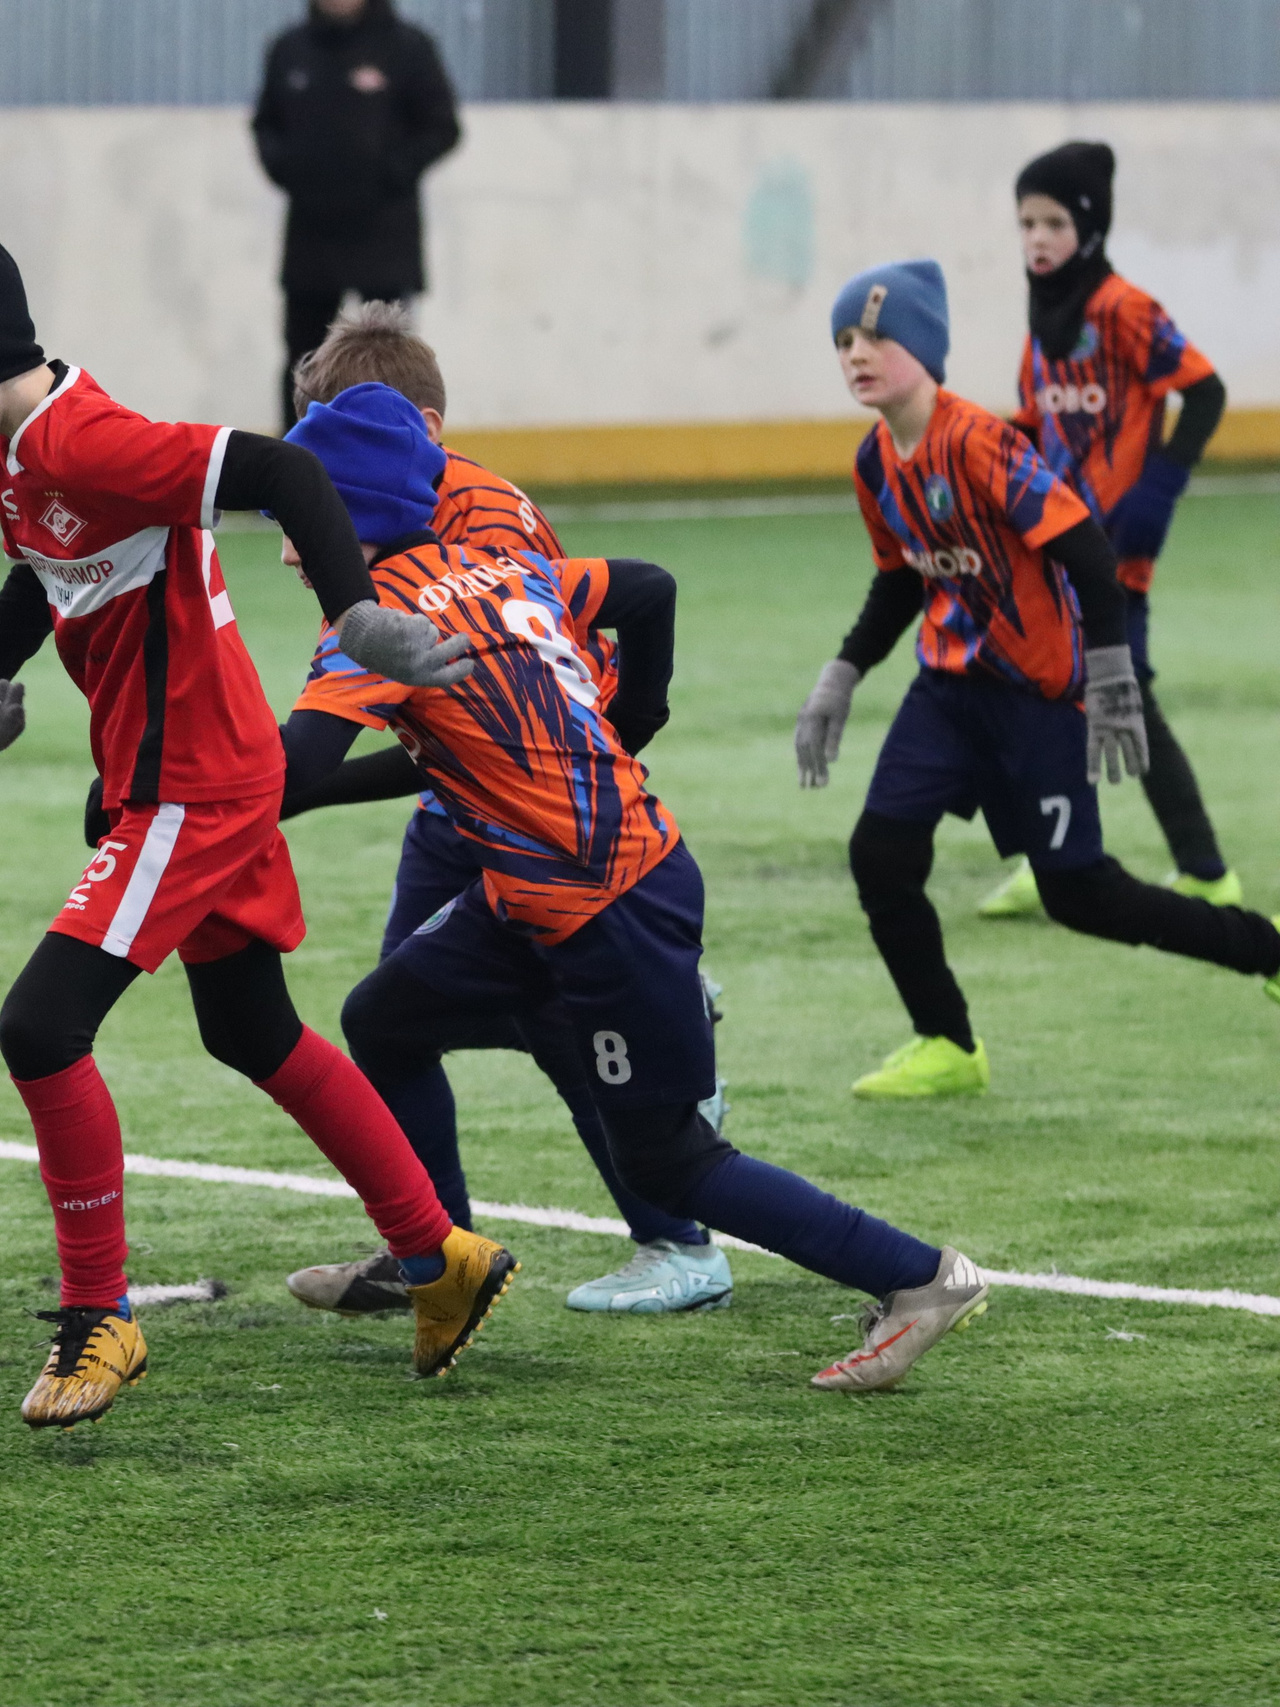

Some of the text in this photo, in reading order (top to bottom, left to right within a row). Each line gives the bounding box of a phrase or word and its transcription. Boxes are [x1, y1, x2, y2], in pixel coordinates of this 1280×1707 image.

[501, 600, 601, 707] 8
[1040, 795, 1071, 851] 7
[593, 1030, 632, 1084] 8
[57, 1190, 121, 1211] JÖGEL
